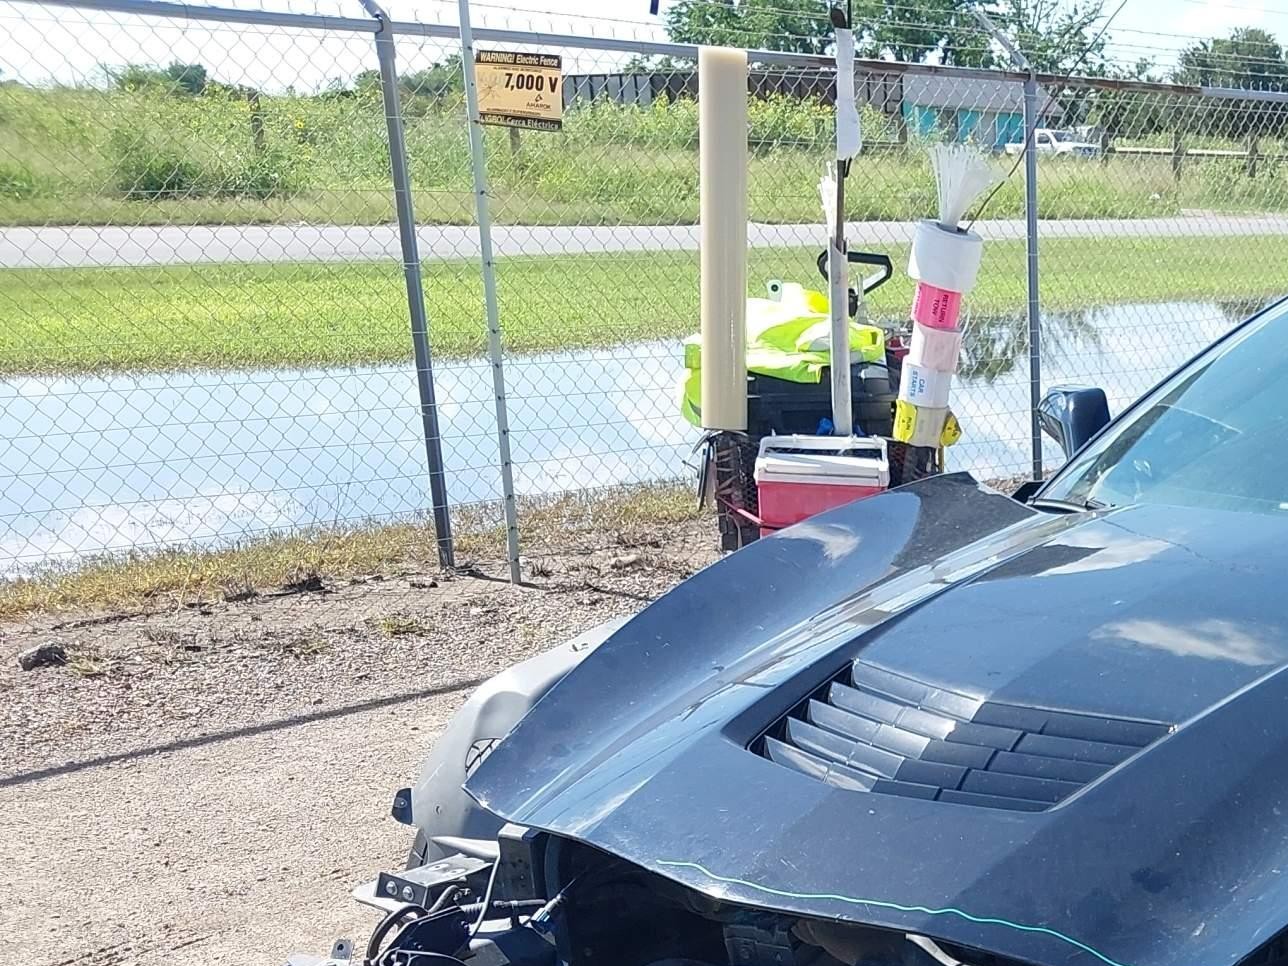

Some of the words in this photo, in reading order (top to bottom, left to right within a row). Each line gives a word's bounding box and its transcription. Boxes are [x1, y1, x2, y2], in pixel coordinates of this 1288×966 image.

[480, 52, 515, 64] WARNING!
[516, 55, 538, 65] Electric
[540, 56, 558, 67] Fence
[505, 73, 544, 91] 7,000
[549, 77, 558, 93] V
[932, 299, 940, 315] TOW
[939, 294, 949, 322] RETURN
[910, 371, 918, 397] STARTS
